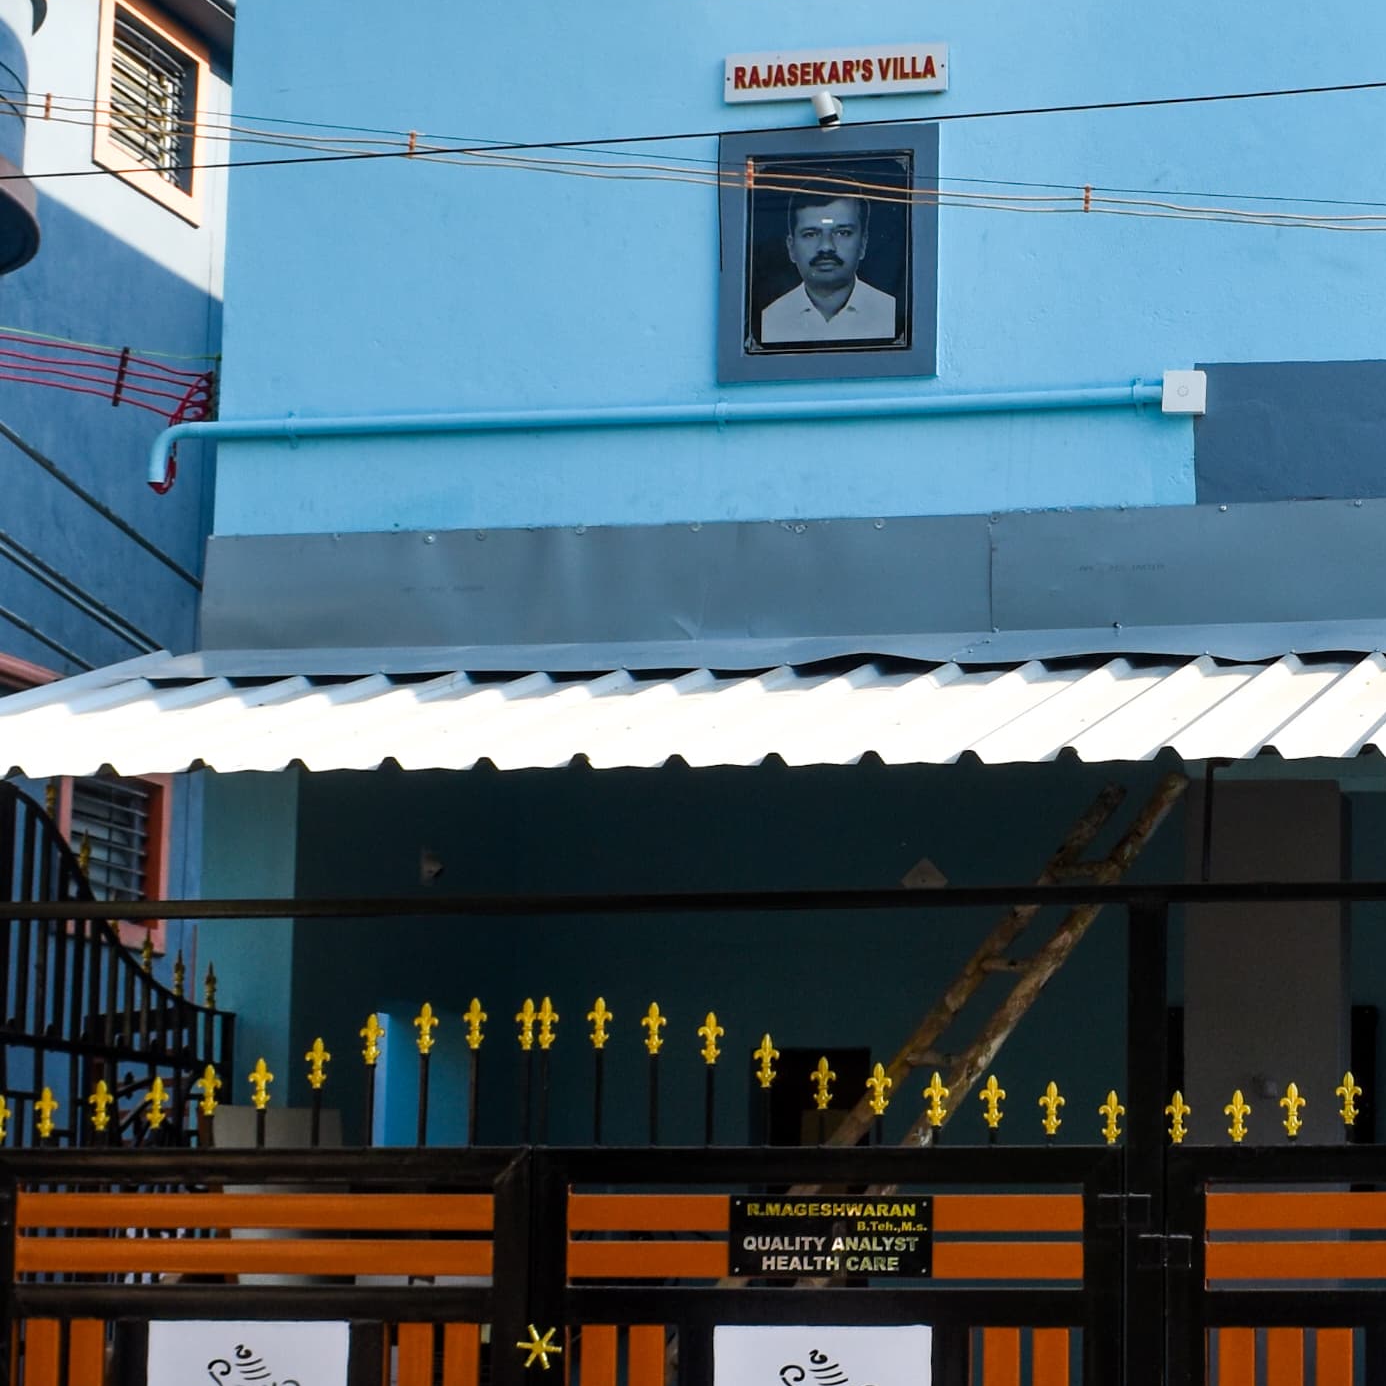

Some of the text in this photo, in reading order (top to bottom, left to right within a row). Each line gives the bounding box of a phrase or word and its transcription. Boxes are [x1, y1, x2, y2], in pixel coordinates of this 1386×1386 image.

[733, 55, 937, 90] RAJASEKAR'S VILLA
[746, 1202, 917, 1217] R.MAGESHWARAN
[742, 1236, 919, 1252] QUALITY ANALYST
[761, 1255, 900, 1271] HEALTH CARE
